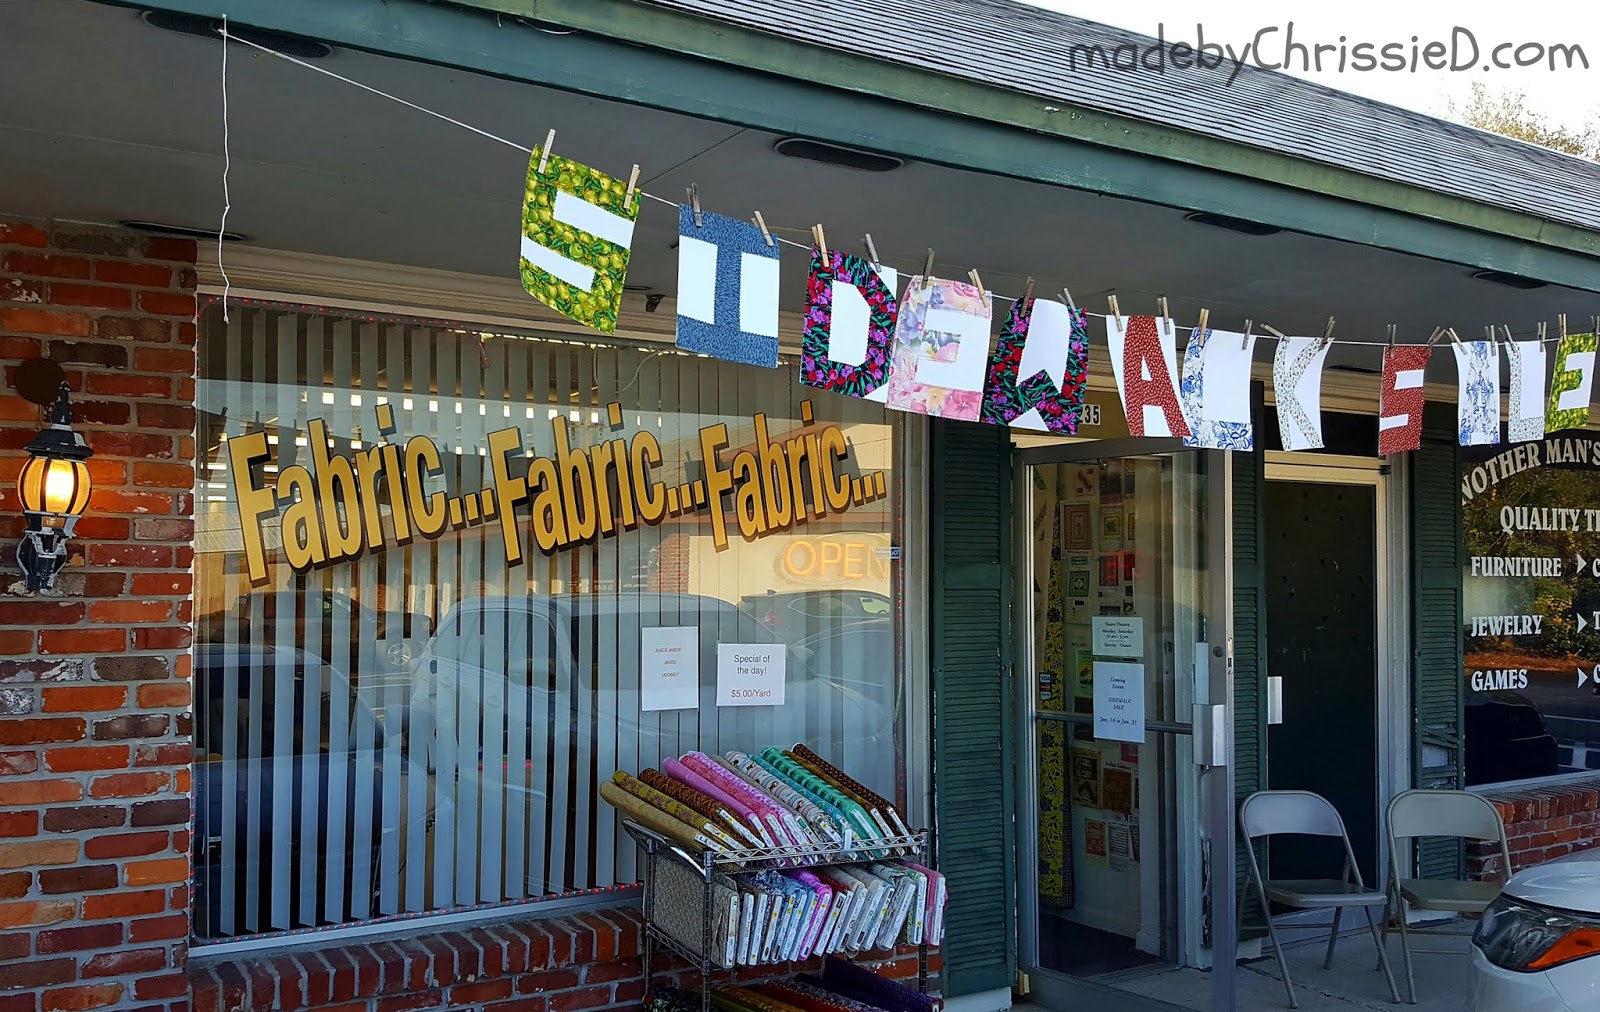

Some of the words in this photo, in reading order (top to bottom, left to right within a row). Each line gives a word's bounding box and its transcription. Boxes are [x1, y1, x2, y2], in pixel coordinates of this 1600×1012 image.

[1079, 404, 1099, 424] 35
[1500, 505, 1580, 535] QUALITY
[784, 540, 889, 579] OPEN
[1471, 556, 1562, 577] FURNITURE
[1471, 614, 1543, 637] JEWELRY
[733, 654, 761, 665] Special
[762, 654, 771, 663] of
[737, 666, 749, 675] the
[750, 666, 767, 677] day!
[1471, 668, 1528, 692] GAMES
[731, 689, 771, 698] $5.00/Yard
